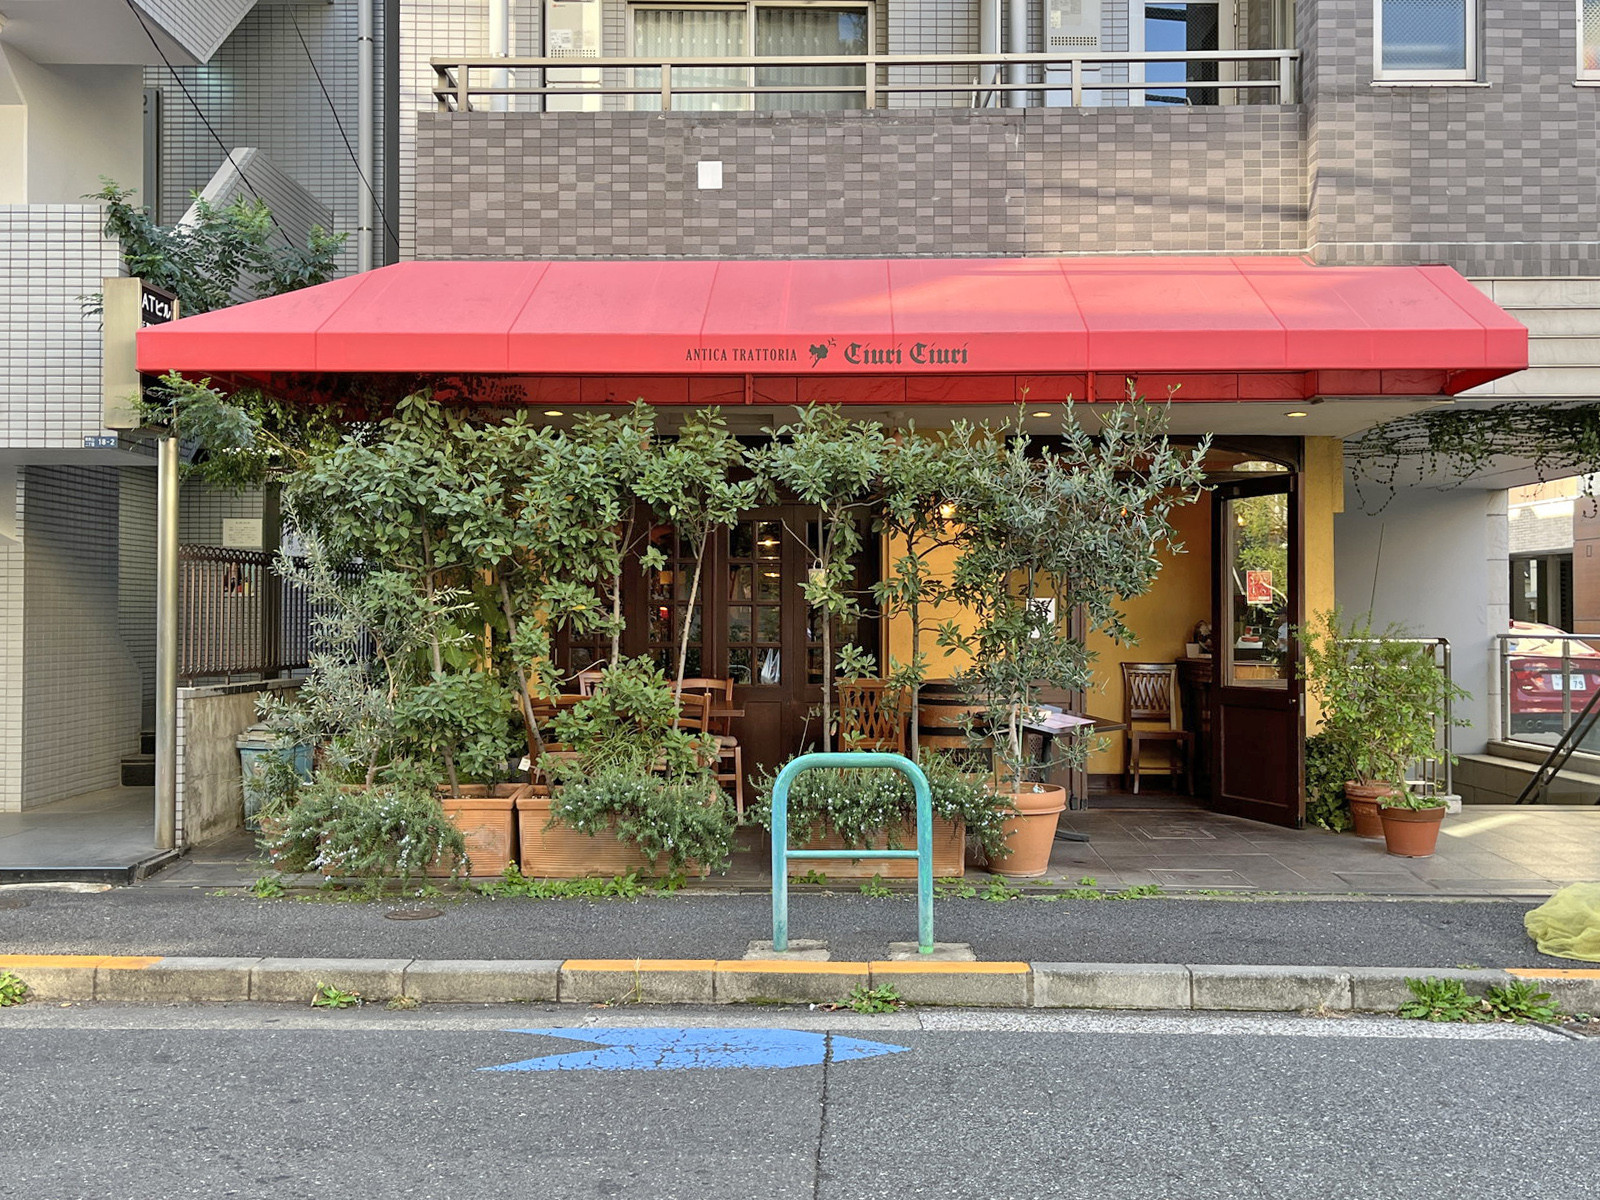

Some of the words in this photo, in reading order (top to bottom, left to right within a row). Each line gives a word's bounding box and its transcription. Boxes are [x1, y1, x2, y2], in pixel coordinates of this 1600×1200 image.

[141, 292, 172, 319] ATビル
[685, 348, 728, 361] ANTICA
[732, 348, 798, 361] TRATTORIA
[844, 342, 903, 365] Ciuri
[909, 342, 969, 365] Ciuri
[98, 438, 115, 446] 18-2
